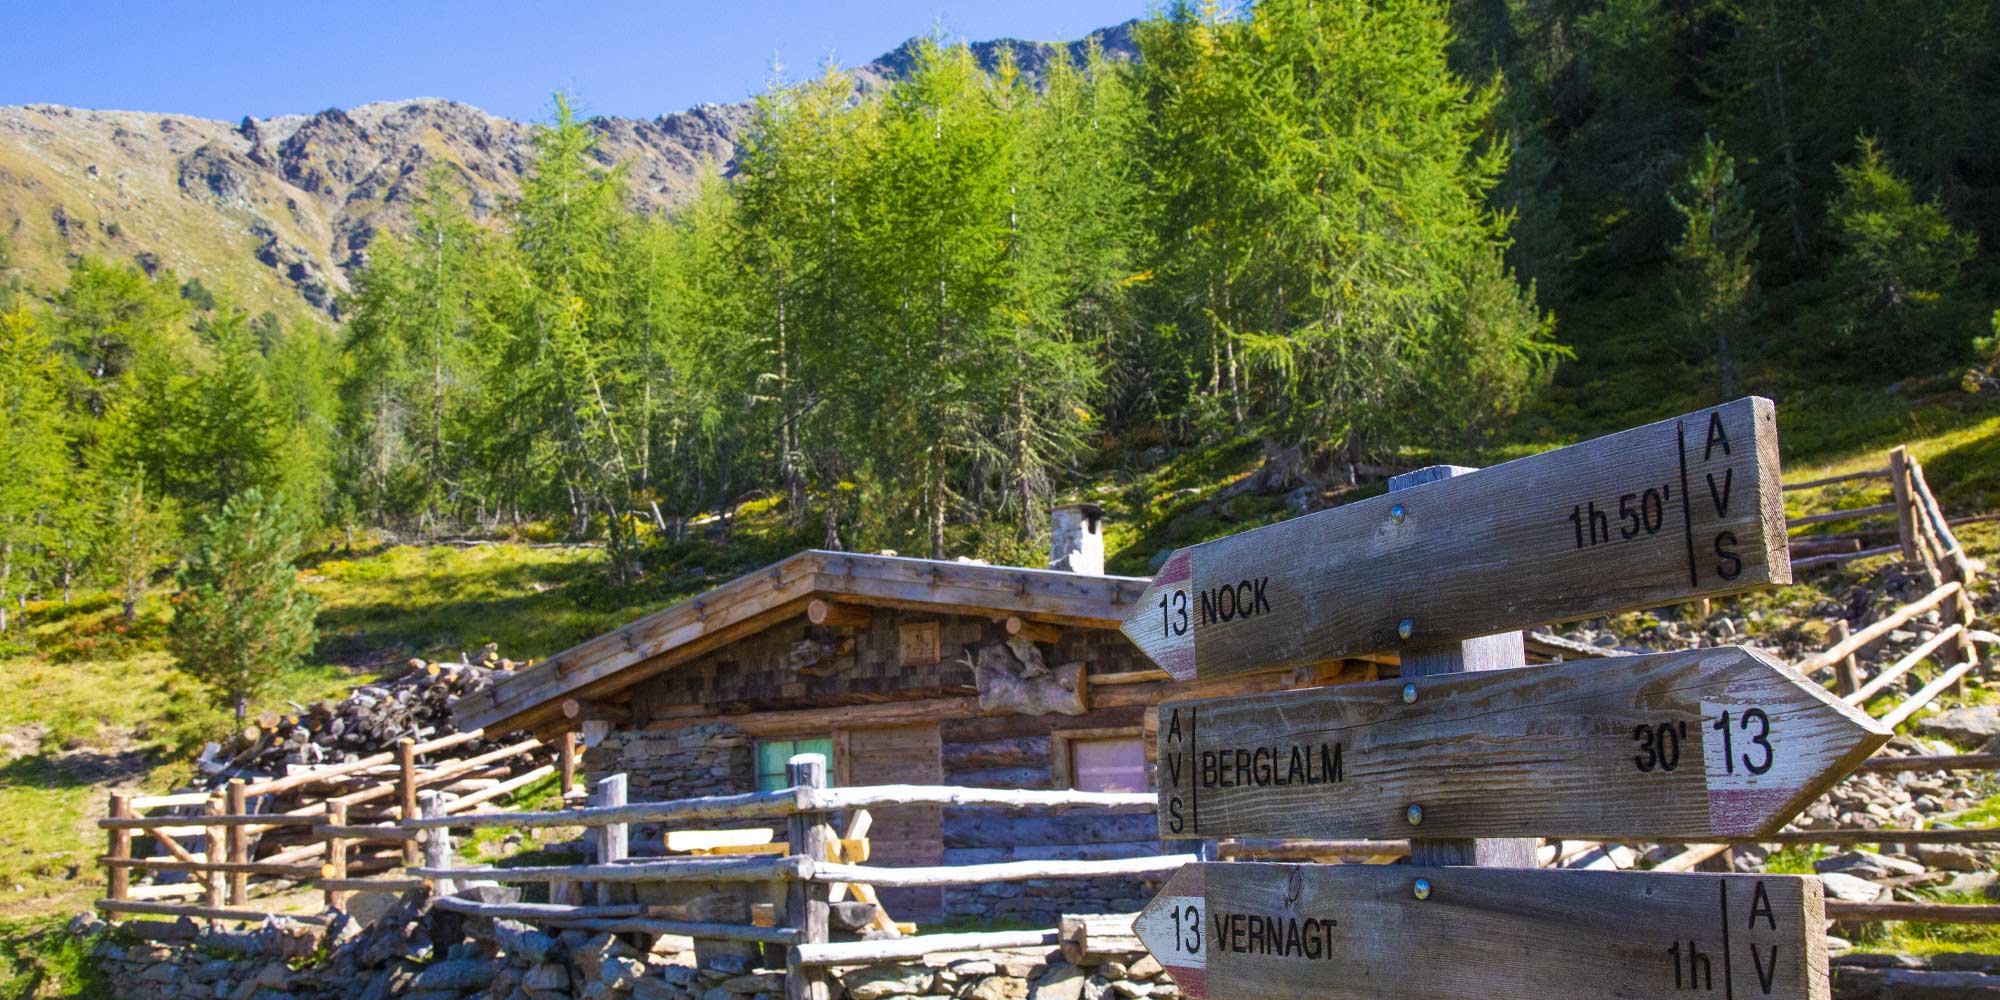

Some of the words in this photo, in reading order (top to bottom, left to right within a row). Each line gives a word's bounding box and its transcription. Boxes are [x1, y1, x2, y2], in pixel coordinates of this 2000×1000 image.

[1569, 500, 1609, 548] 1h
[1619, 483, 1669, 540] 50'
[1704, 411, 1742, 581] AVS
[1159, 589, 1188, 637] 13
[1201, 575, 1271, 626] NOCK
[1167, 707, 1184, 834] AVS
[1202, 742, 1343, 788] BERGLALM
[1633, 720, 1687, 773] 30'
[1713, 707, 1773, 775] 13
[1170, 904, 1201, 954] 13
[1213, 912, 1338, 961] VERNAGT
[1667, 940, 1712, 991] 1h
